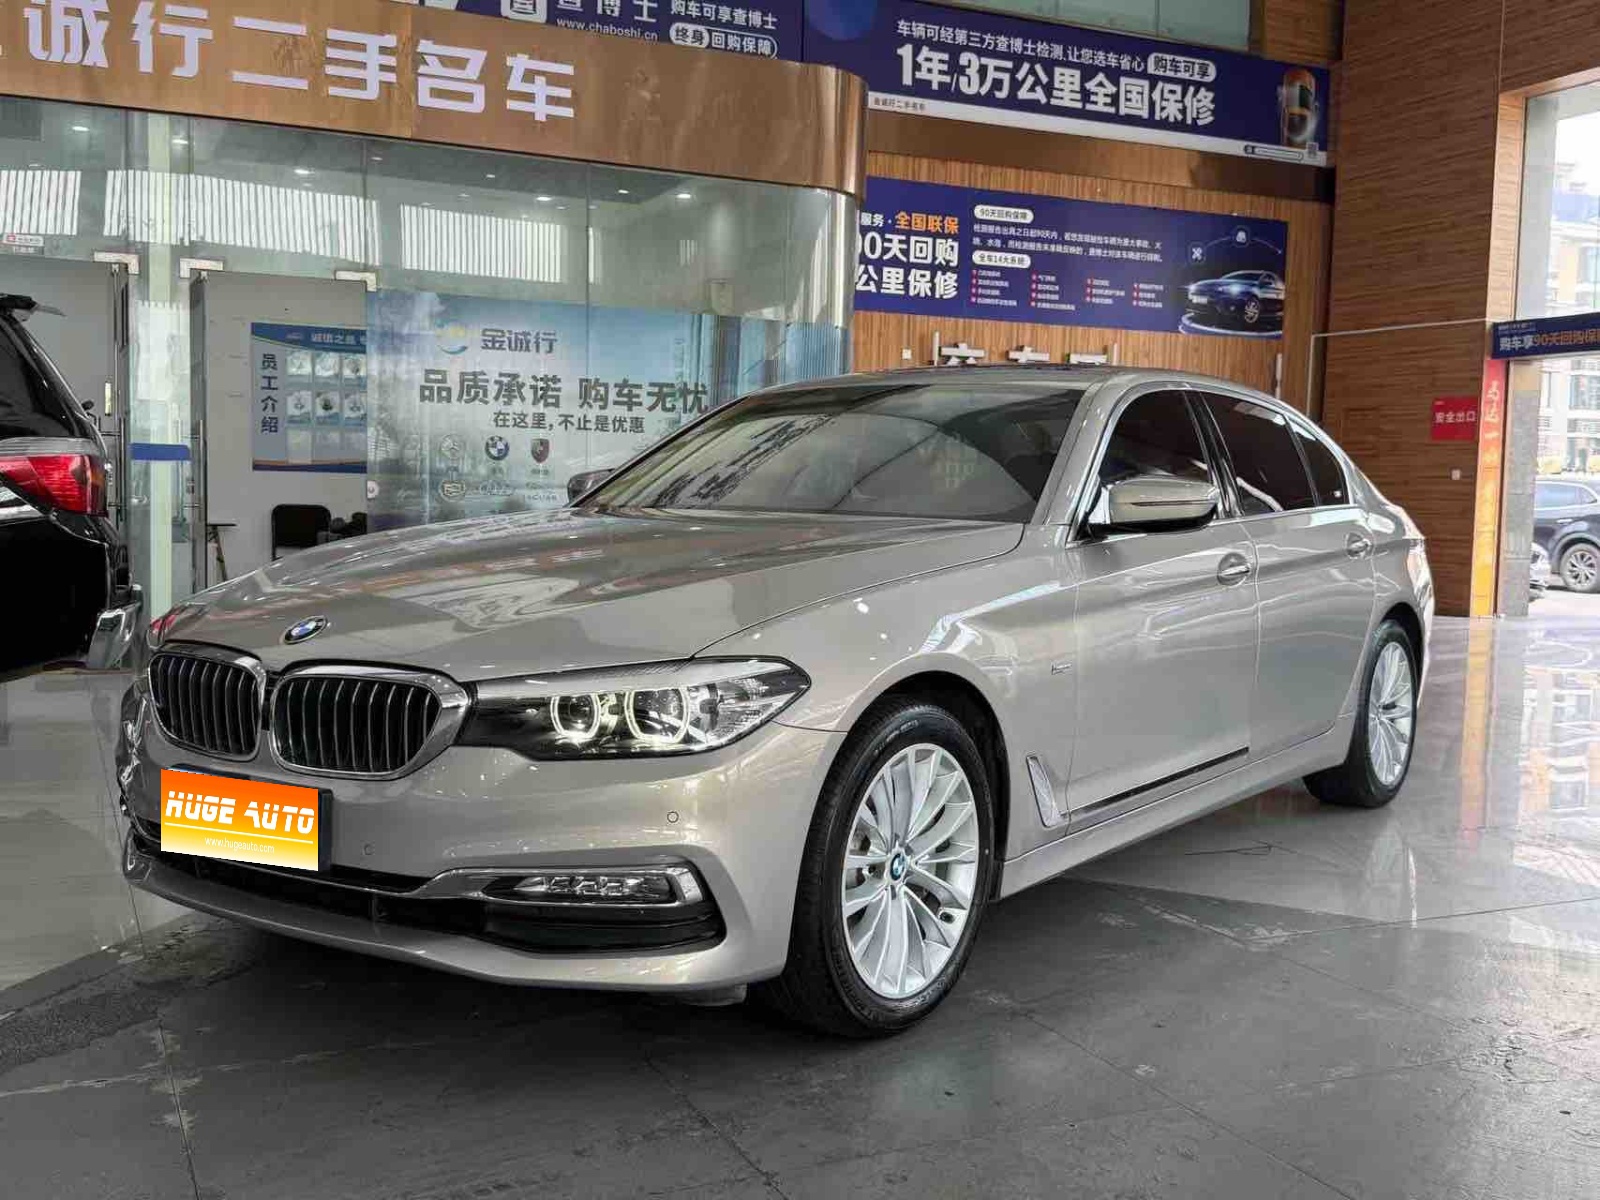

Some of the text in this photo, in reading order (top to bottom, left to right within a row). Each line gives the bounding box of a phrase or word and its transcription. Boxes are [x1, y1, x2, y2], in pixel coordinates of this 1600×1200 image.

[670, 0, 778, 30] 购车可享查博士
[556, 18, 659, 41] www.chaboshi.cn
[711, 32, 773, 56] 回购保障
[1153, 54, 1211, 80] 购车可享
[896, 43, 1216, 126] 1年/3万公里全国保修
[855, 264, 959, 299] 公里保修
[481, 327, 558, 354] 金诚行
[260, 353, 279, 435] 员工介绍
[419, 368, 709, 415] 品质承诺 购车无忧
[1434, 410, 1477, 424] 安全出口
